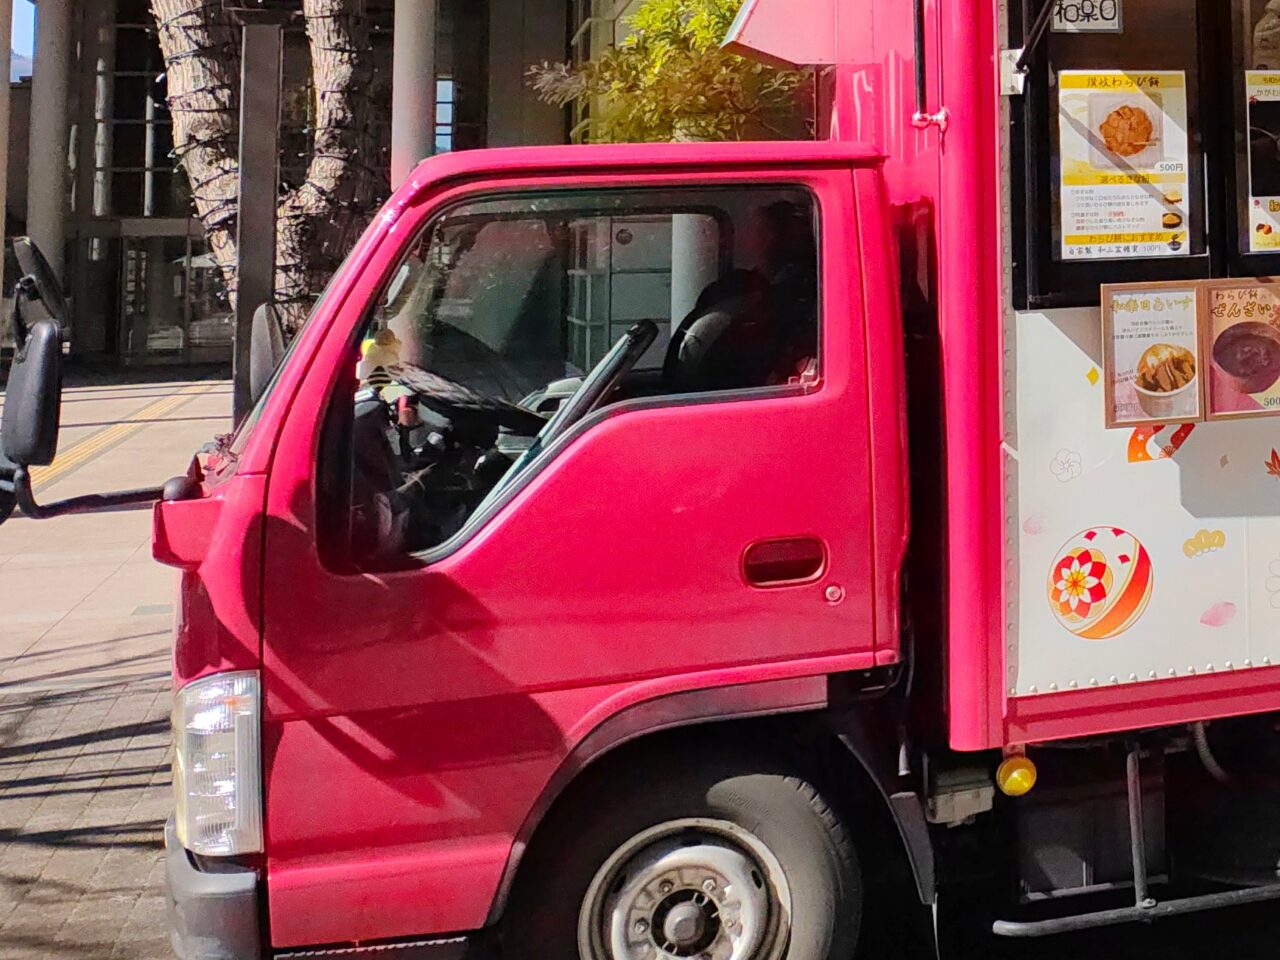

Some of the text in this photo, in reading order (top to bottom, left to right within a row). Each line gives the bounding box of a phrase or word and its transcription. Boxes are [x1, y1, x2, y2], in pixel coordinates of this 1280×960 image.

[1159, 163, 1184, 172] 500円
[1212, 301, 1271, 318] ぜんざい
